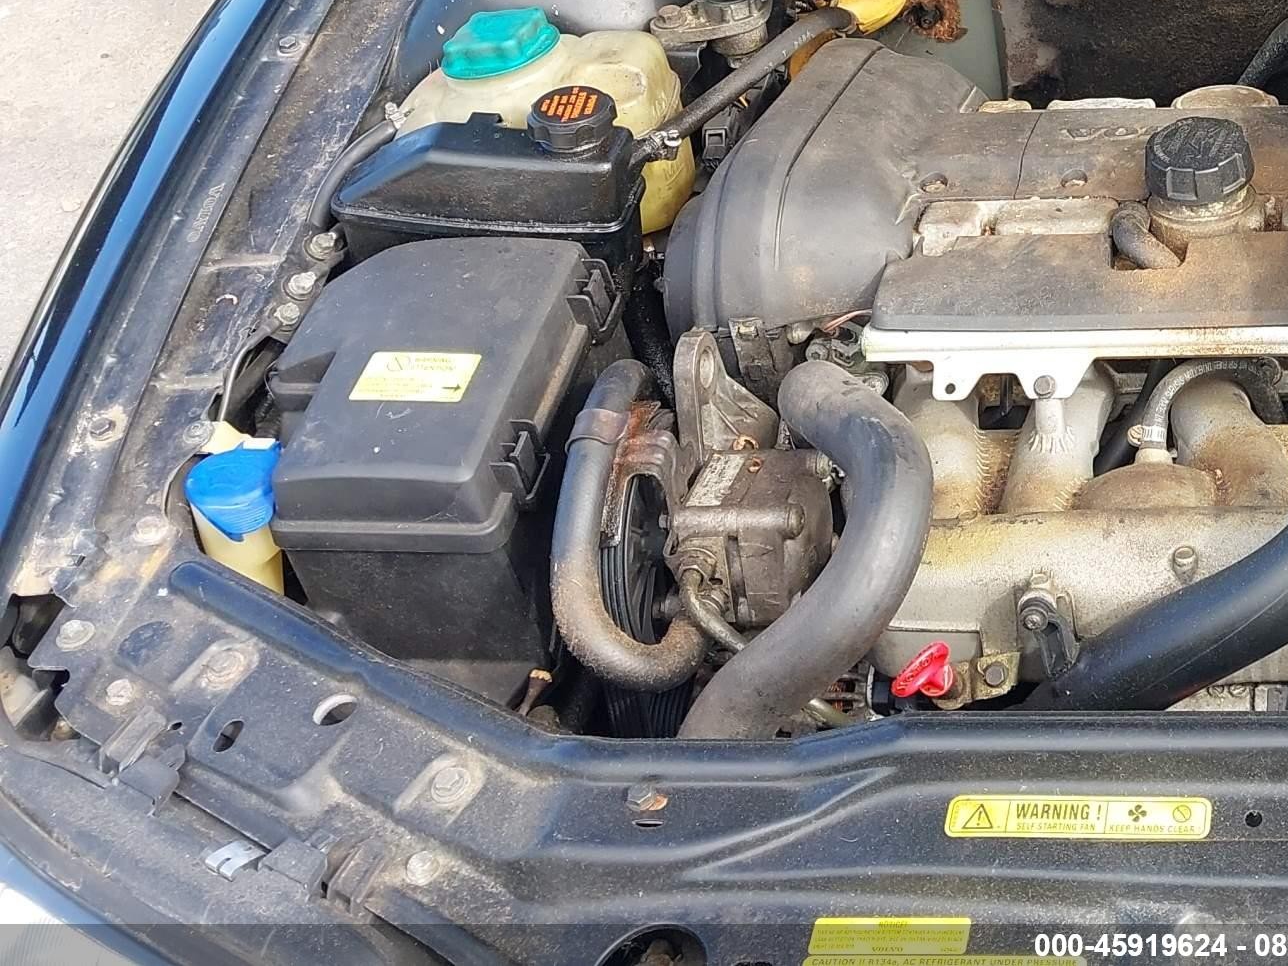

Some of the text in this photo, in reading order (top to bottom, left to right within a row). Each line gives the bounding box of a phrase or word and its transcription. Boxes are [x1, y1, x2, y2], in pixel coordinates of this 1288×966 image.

[1016, 803, 1090, 821] WARNING
[1079, 823, 1096, 831] FAN
[1109, 824, 1132, 832] KEEP
[1133, 825, 1165, 833] HANDS
[811, 958, 856, 966] CAUTION
[902, 958, 915, 966] AC
[918, 958, 986, 966] REFRIGERANT
[989, 958, 1024, 966] UNDER
[1026, 958, 1078, 966] PRESSURE
